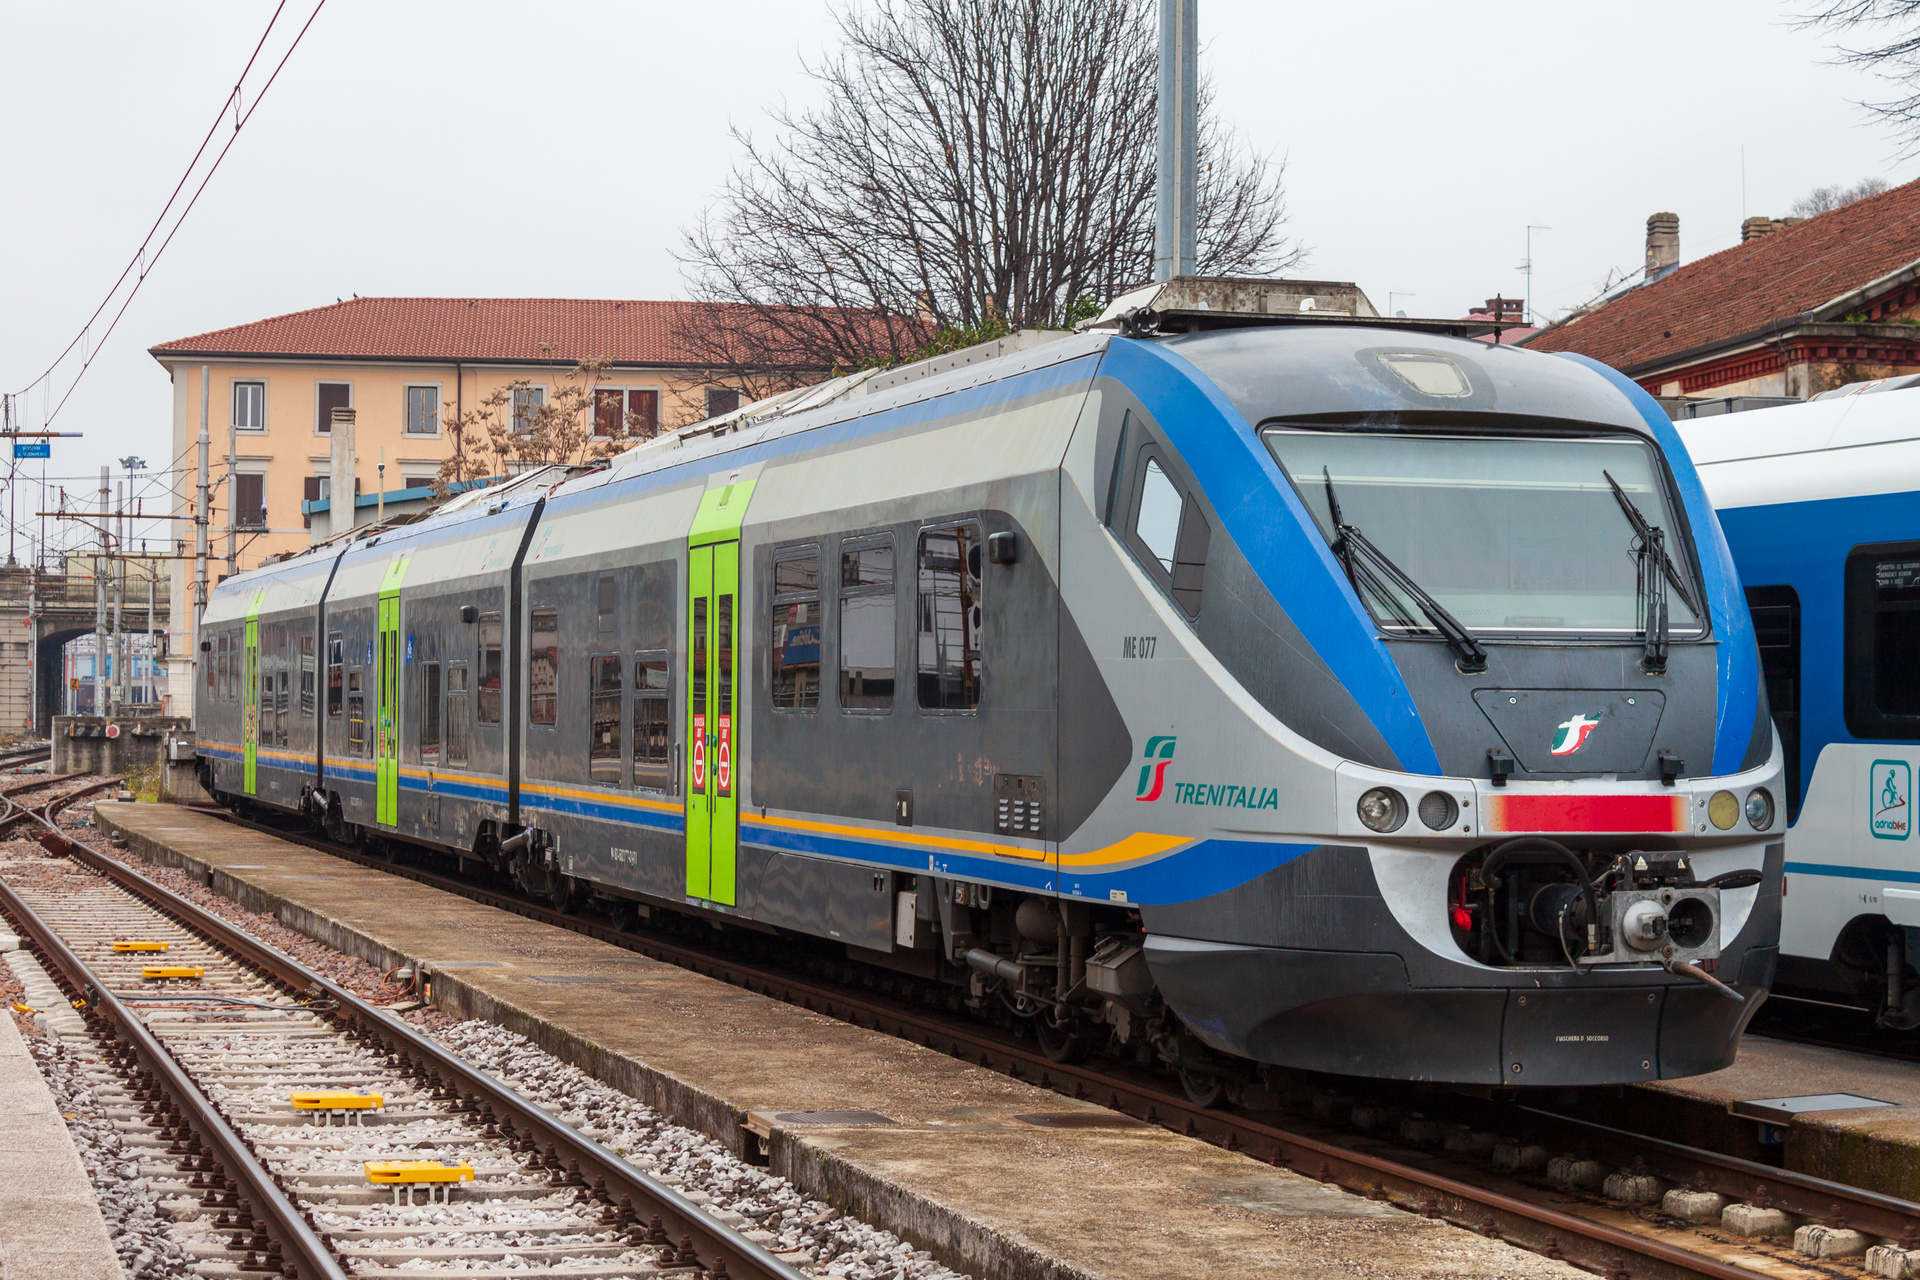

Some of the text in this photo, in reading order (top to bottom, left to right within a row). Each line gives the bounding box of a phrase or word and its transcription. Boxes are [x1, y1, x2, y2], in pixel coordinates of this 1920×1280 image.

[1123, 636, 1157, 660] ME 077
[1174, 782, 1278, 810] TRENITALIA
